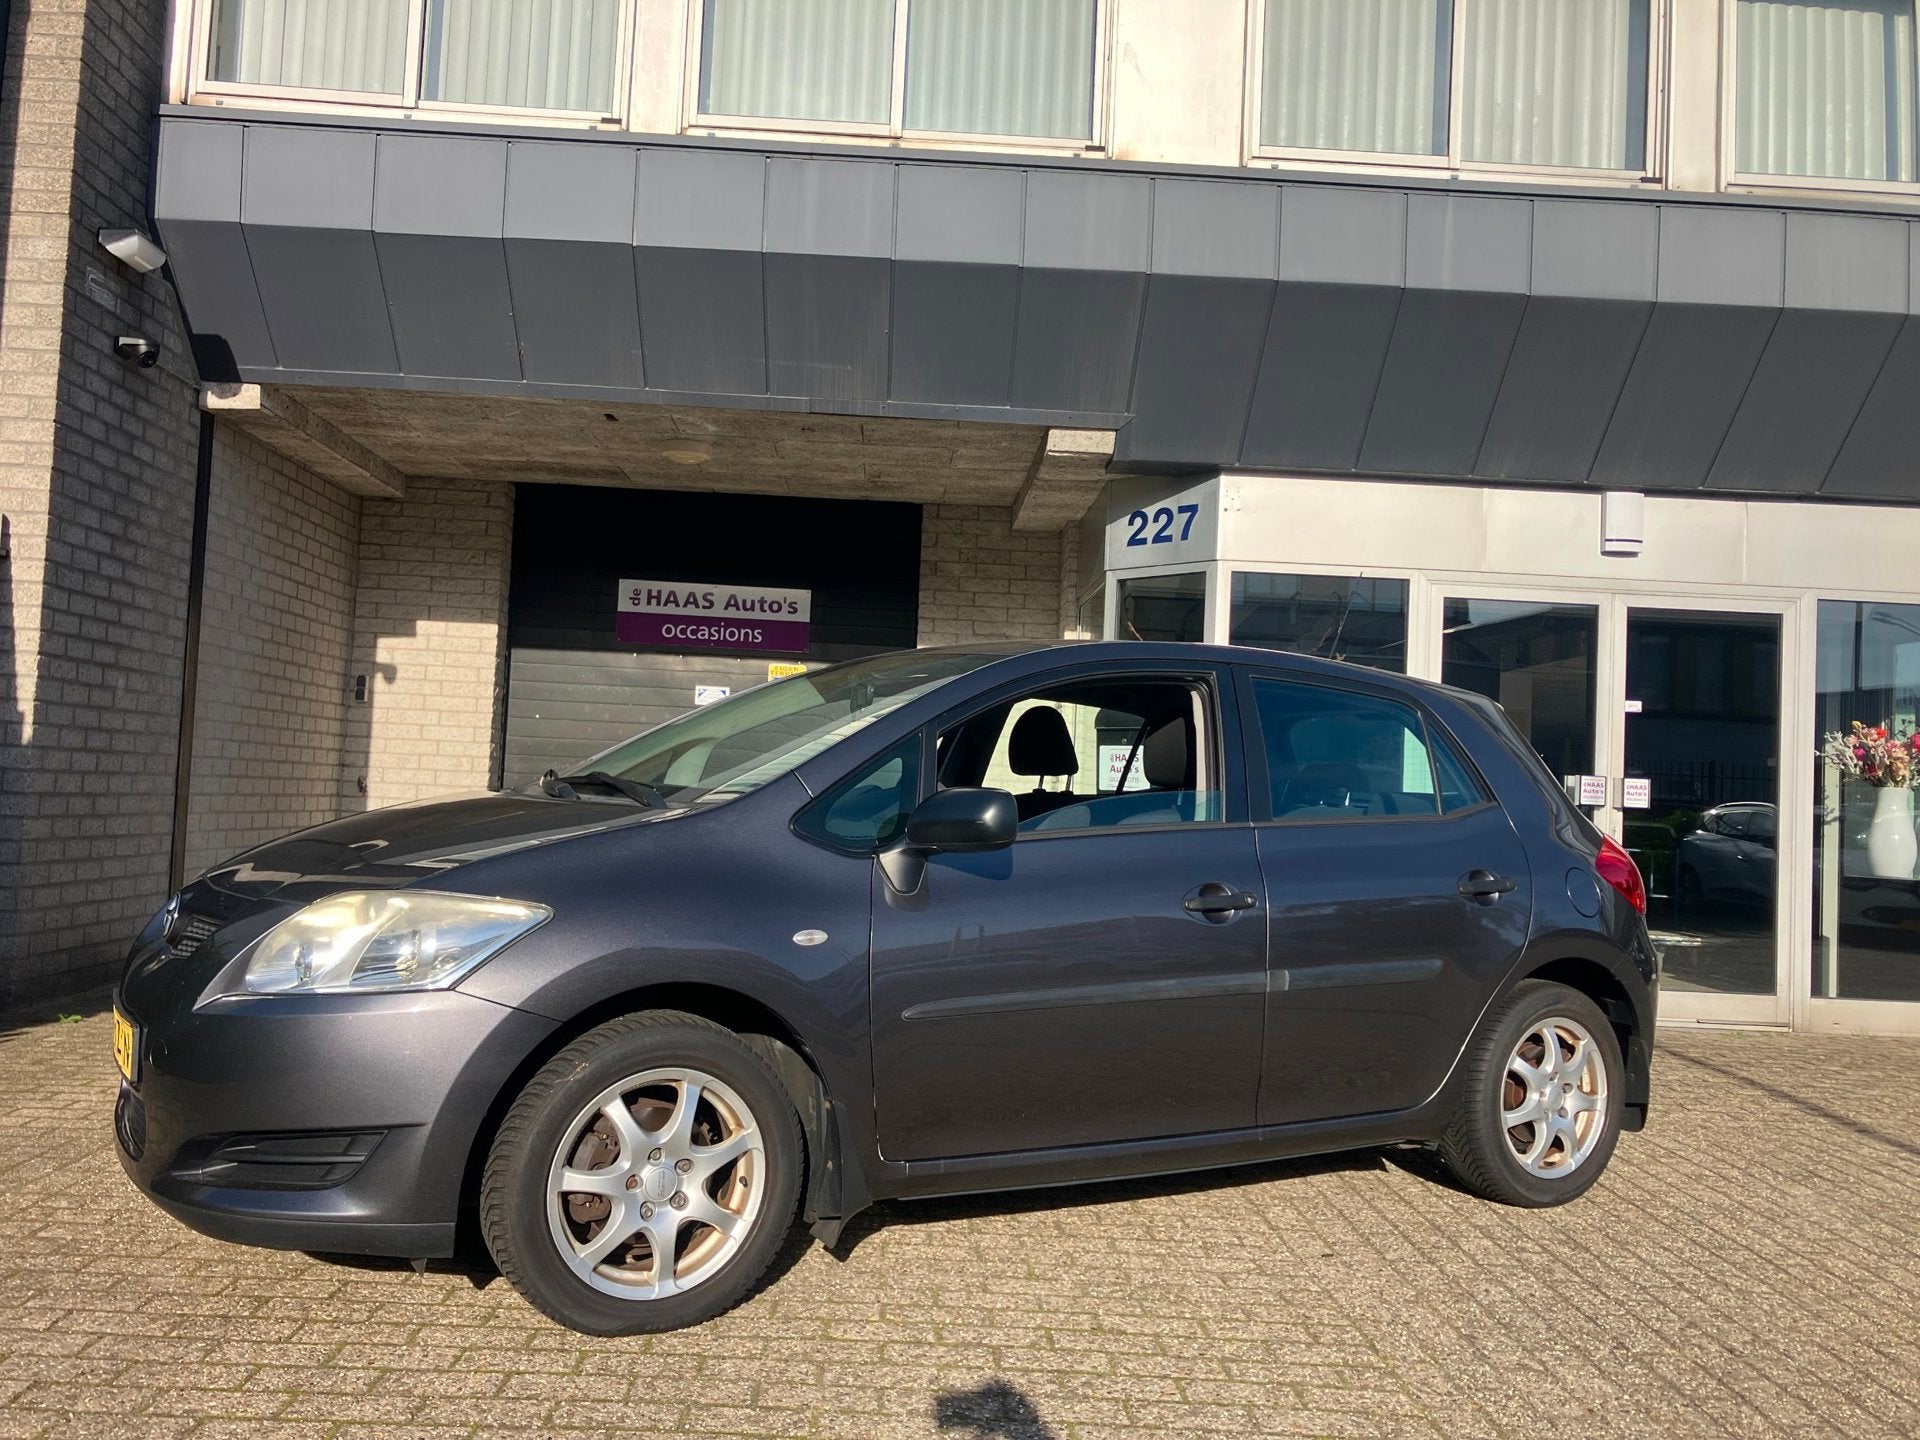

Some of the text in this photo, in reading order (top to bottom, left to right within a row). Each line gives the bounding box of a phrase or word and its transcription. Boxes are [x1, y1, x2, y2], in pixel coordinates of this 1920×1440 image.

[1126, 503, 1199, 547] 227
[628, 588, 799, 615] de HAAS Auto's
[661, 621, 763, 643] occasions
[1115, 754, 1139, 762] HAS
